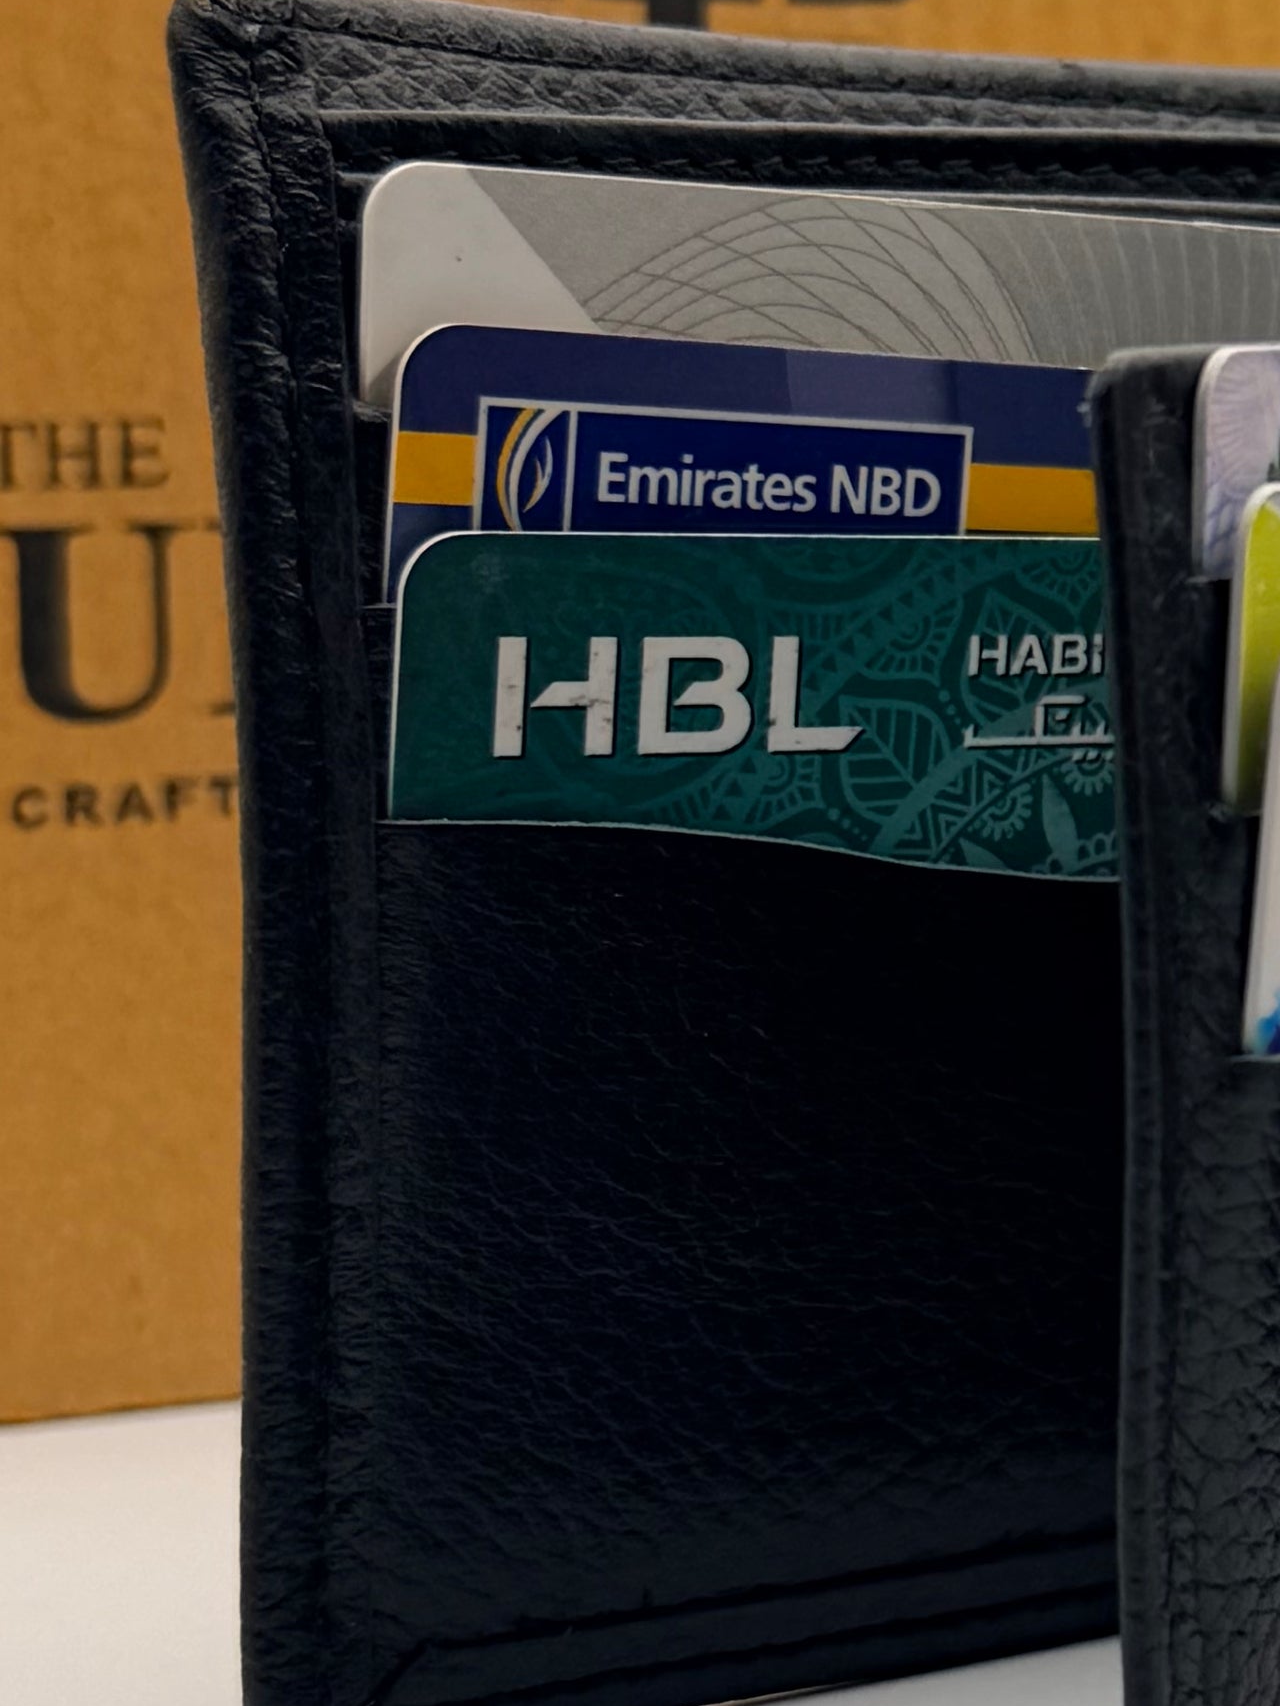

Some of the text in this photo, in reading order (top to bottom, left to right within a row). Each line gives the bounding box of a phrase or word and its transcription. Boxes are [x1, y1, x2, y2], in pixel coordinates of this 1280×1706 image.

[598, 450, 942, 518] Emirates NBD
[492, 634, 865, 758] HBL
